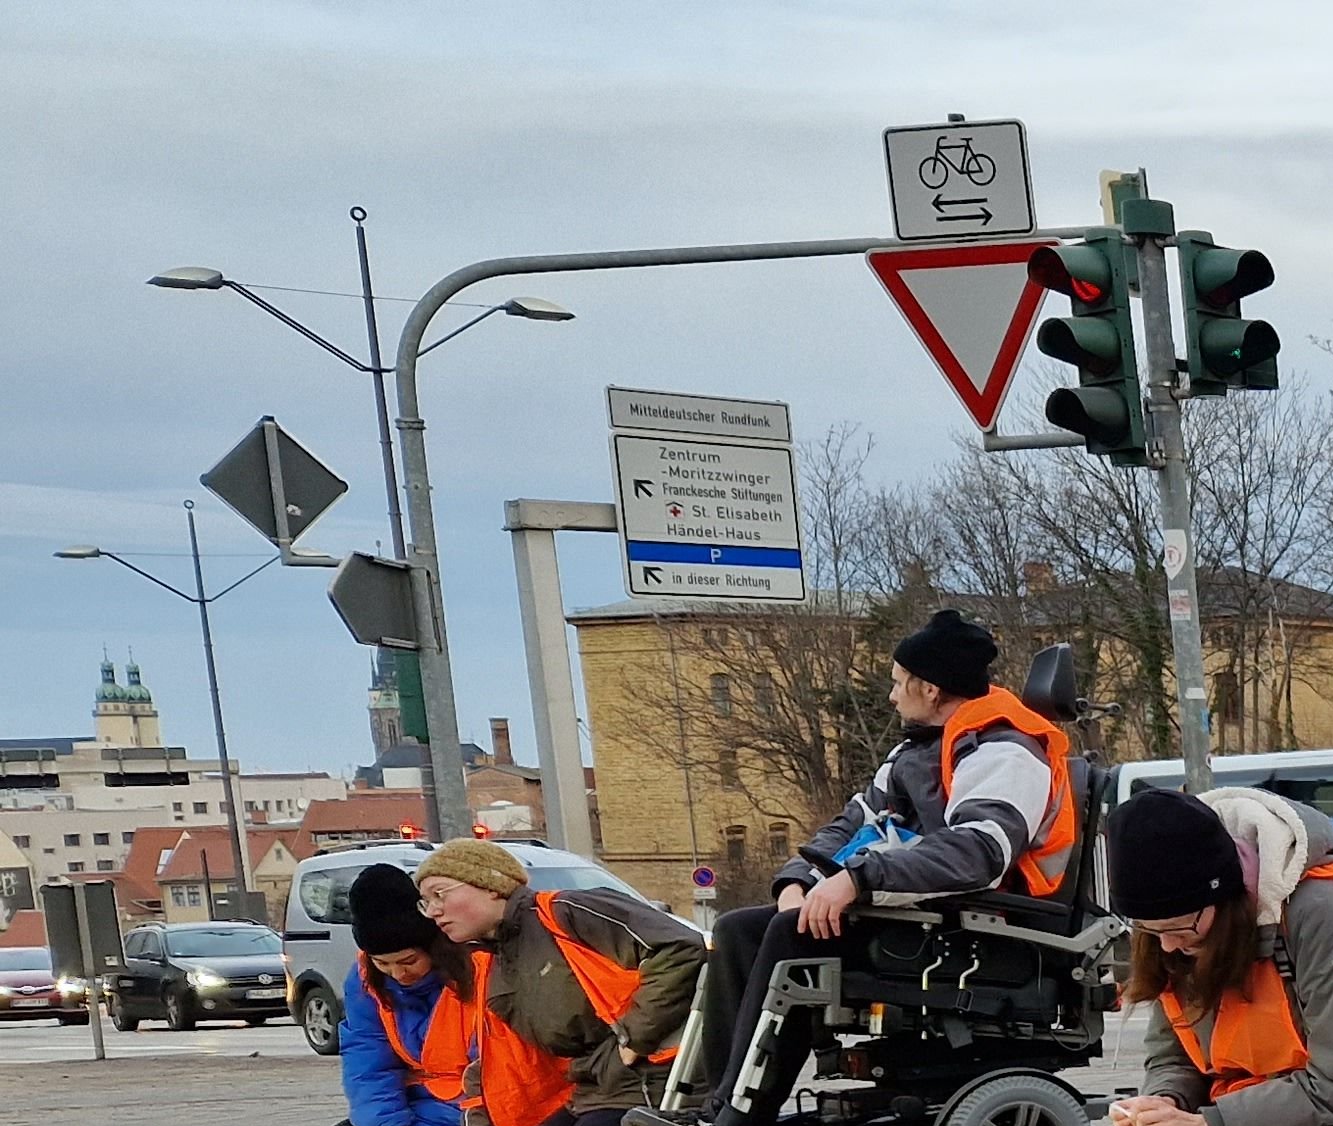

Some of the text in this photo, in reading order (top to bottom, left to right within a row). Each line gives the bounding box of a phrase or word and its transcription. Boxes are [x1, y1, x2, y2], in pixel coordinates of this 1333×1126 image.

[629, 403, 771, 428] Mitteldeutscher Rundfunk
[659, 446, 721, 463] Zentrum
[662, 482, 783, 504] Franckesche Stiftungen
[692, 505, 782, 522] St. Elisabeth
[667, 523, 761, 541] Händel-Haus
[710, 548, 722, 563] P
[672, 573, 771, 590] in dieser Richtung
